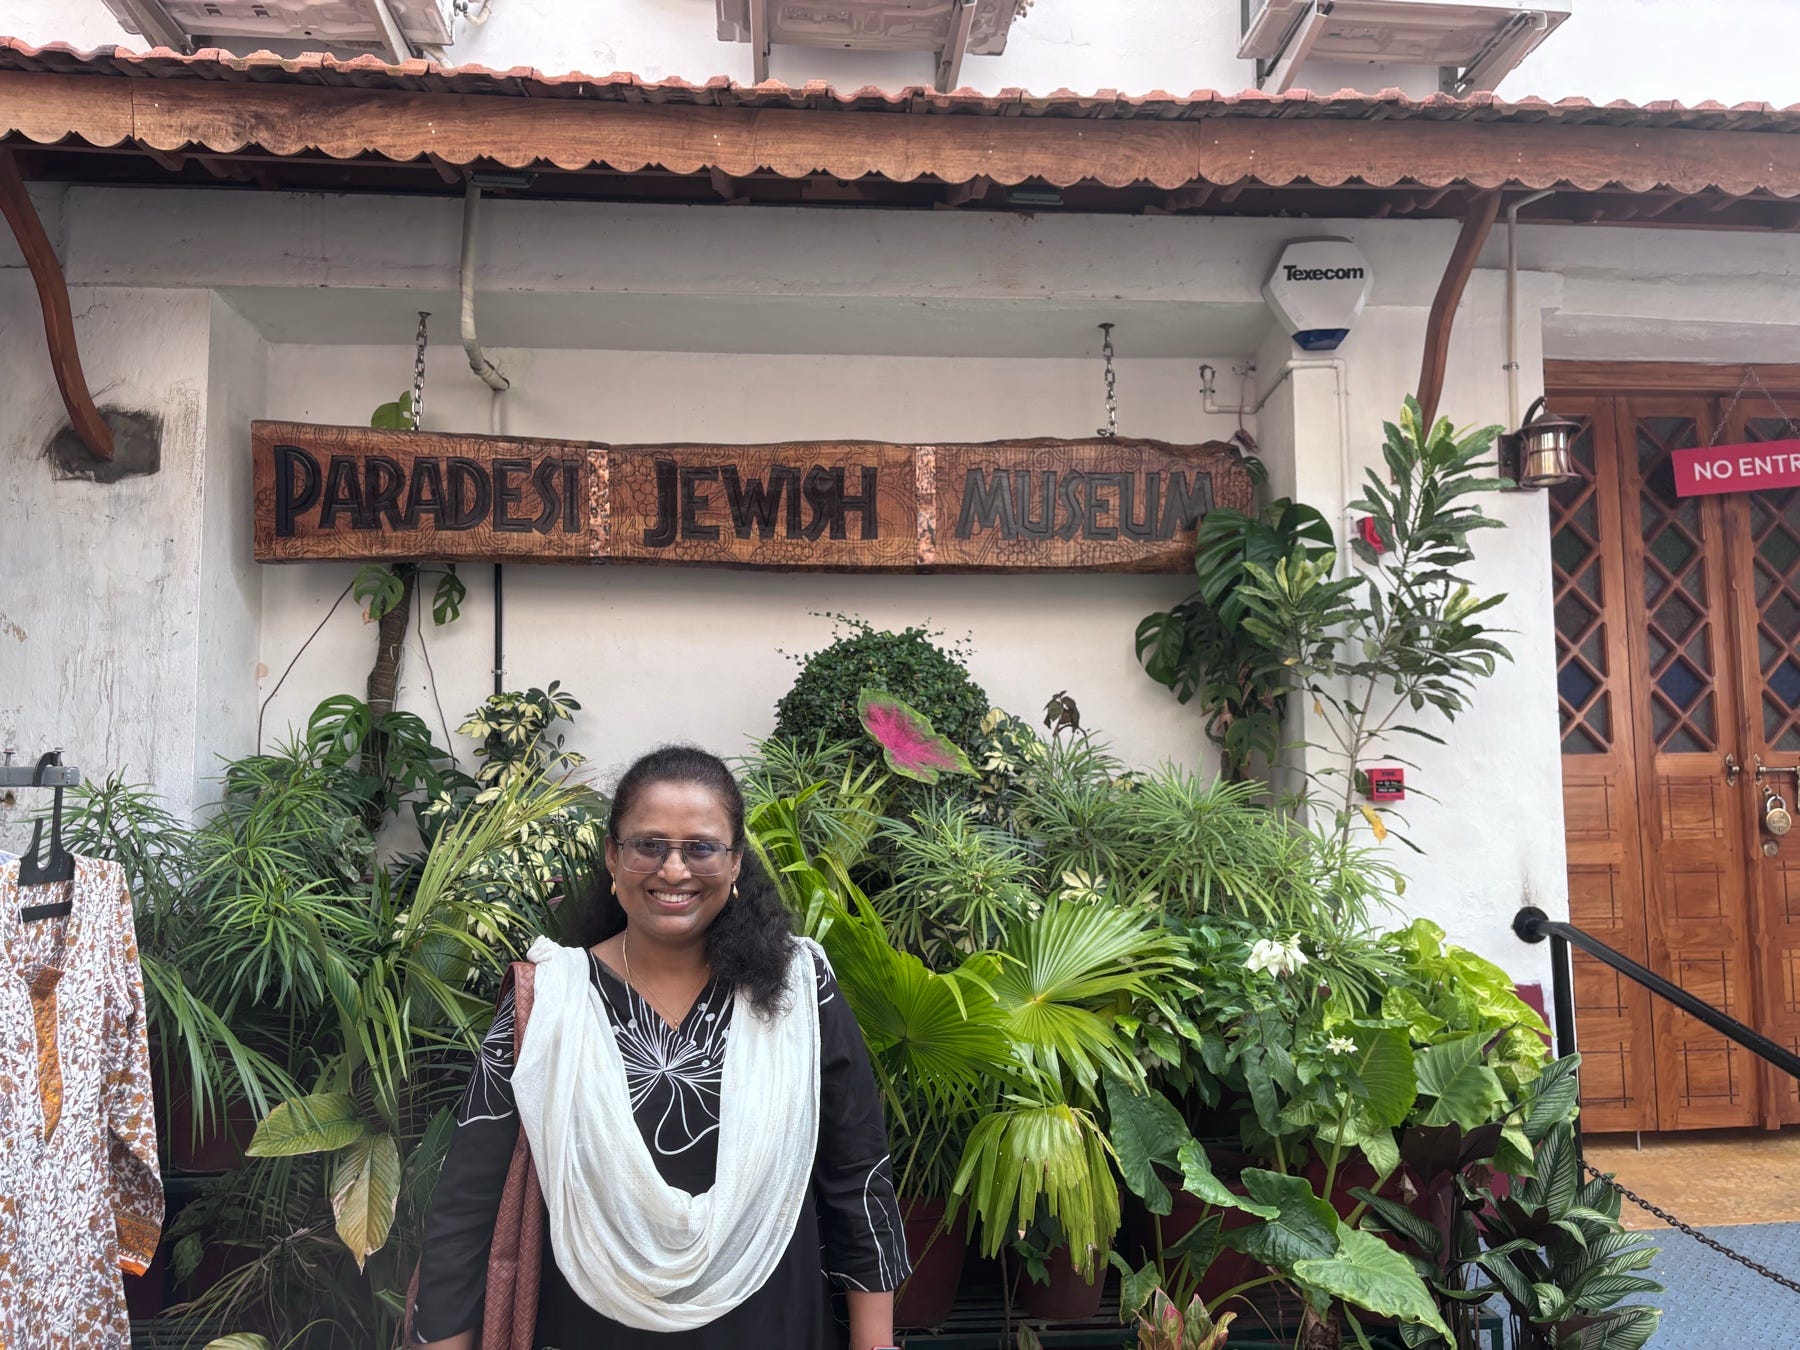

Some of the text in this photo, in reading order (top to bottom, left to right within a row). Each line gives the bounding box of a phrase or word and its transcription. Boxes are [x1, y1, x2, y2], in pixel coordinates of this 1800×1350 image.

[1283, 265, 1364, 281] Texecom
[1693, 460, 1733, 481] NO
[273, 445, 1216, 548] PARADESI JEWISH MUSEUM
